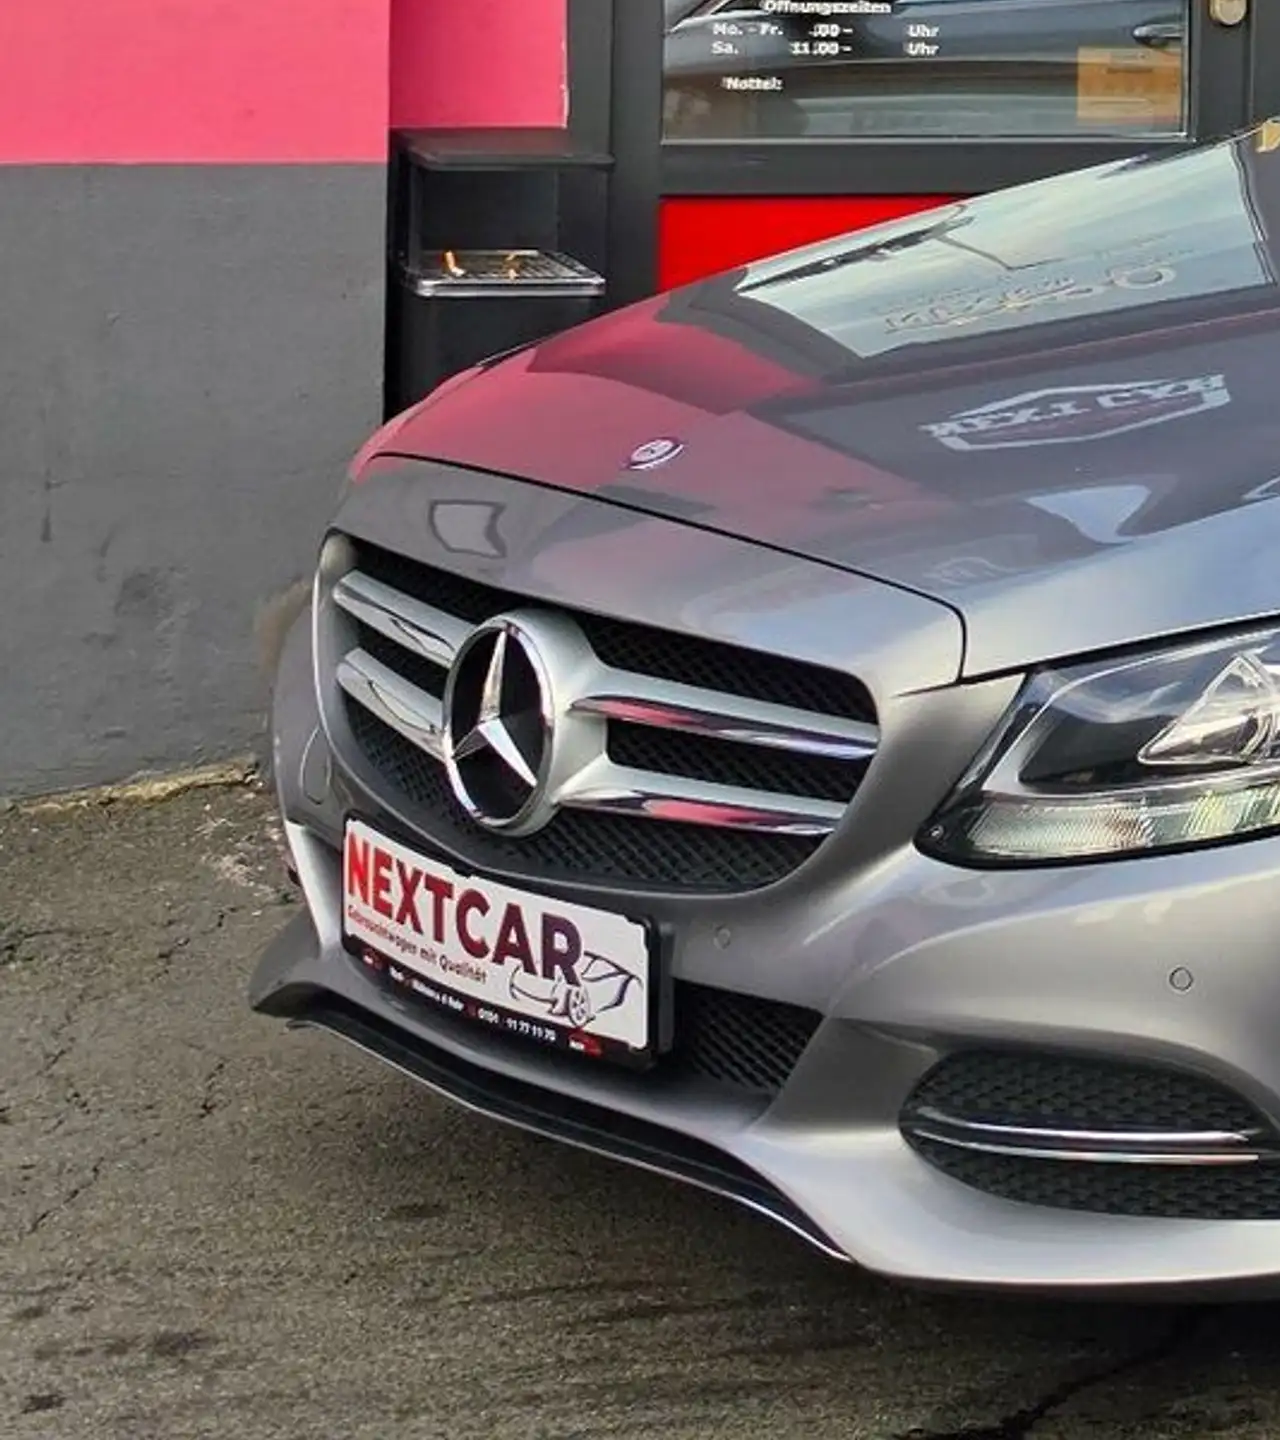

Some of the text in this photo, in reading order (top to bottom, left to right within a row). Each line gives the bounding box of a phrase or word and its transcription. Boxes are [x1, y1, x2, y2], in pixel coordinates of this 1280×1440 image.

[712, 23, 743, 36] Mo.
[759, 22, 784, 35] Fr.
[907, 24, 939, 37] Uhr
[711, 41, 739, 55] Sa.
[907, 42, 939, 56] Uhr
[347, 830, 583, 988] NEXTCAR
